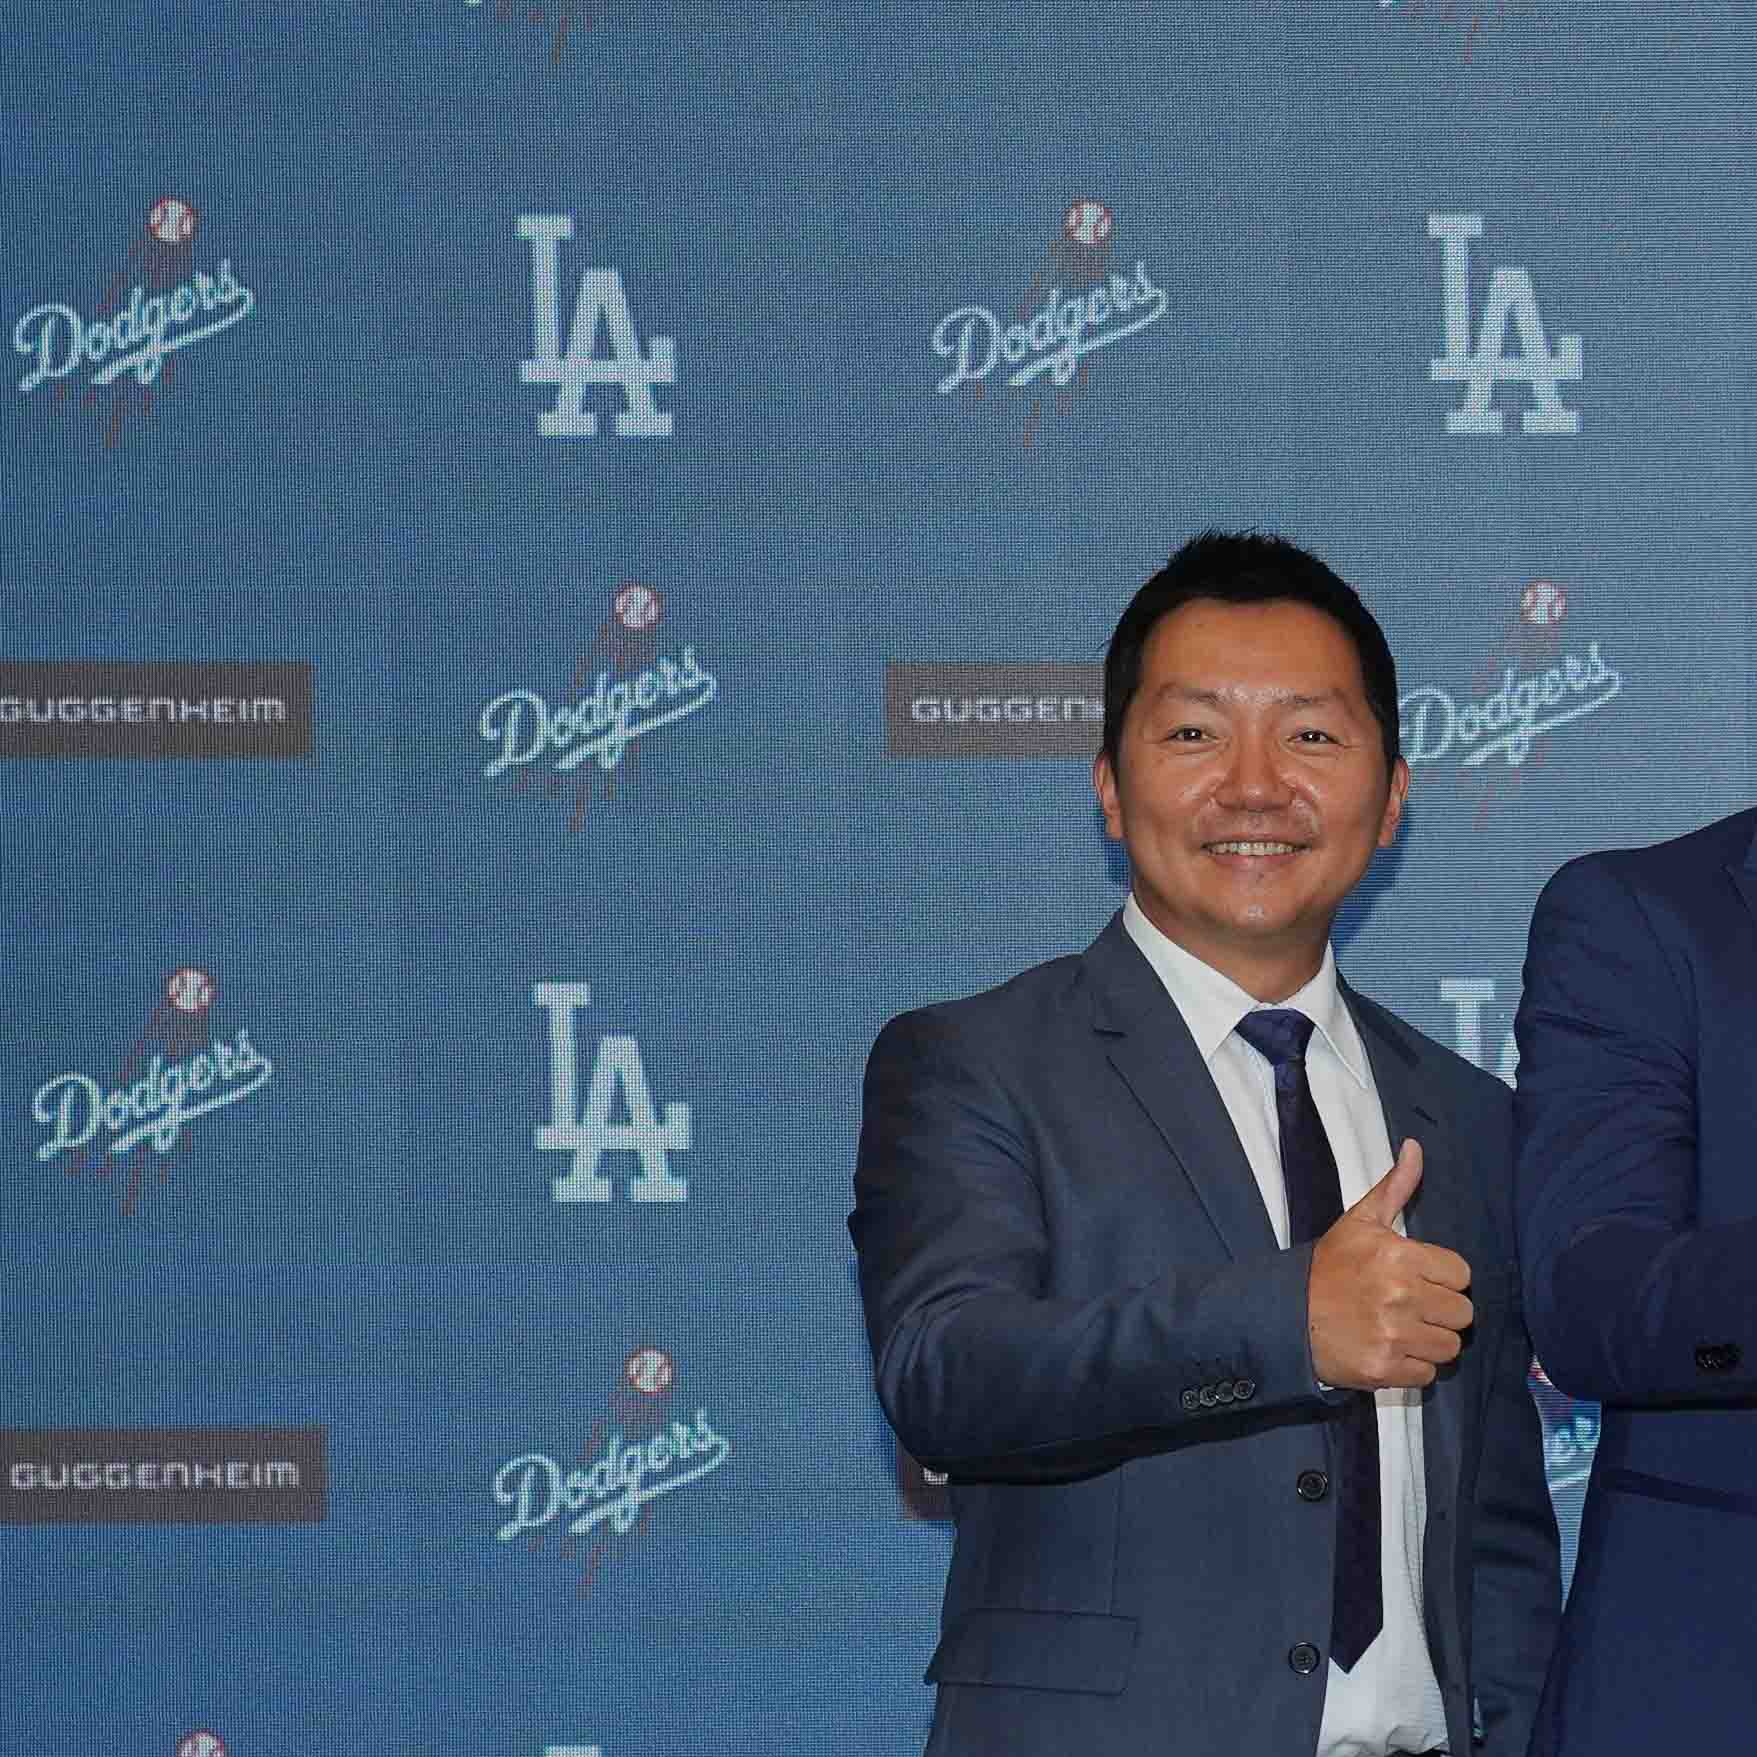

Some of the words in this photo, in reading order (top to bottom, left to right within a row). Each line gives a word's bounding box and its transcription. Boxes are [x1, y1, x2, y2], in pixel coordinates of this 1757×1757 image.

[15, 261, 254, 390] Dodgers
[519, 216, 674, 435] LA
[933, 264, 1167, 392] Dodgers
[1429, 215, 1582, 433] LA
[0, 696, 286, 723] GUGGENHEIM
[480, 650, 716, 775] Dodgers
[911, 696, 1104, 723] GUGGEN
[1400, 642, 1621, 767] Dodgers
[34, 1033, 272, 1158] Dodgers
[536, 983, 689, 1201] LA
[10, 1461, 300, 1489] GUGGENHEIM
[494, 1411, 729, 1539] Dodgers
